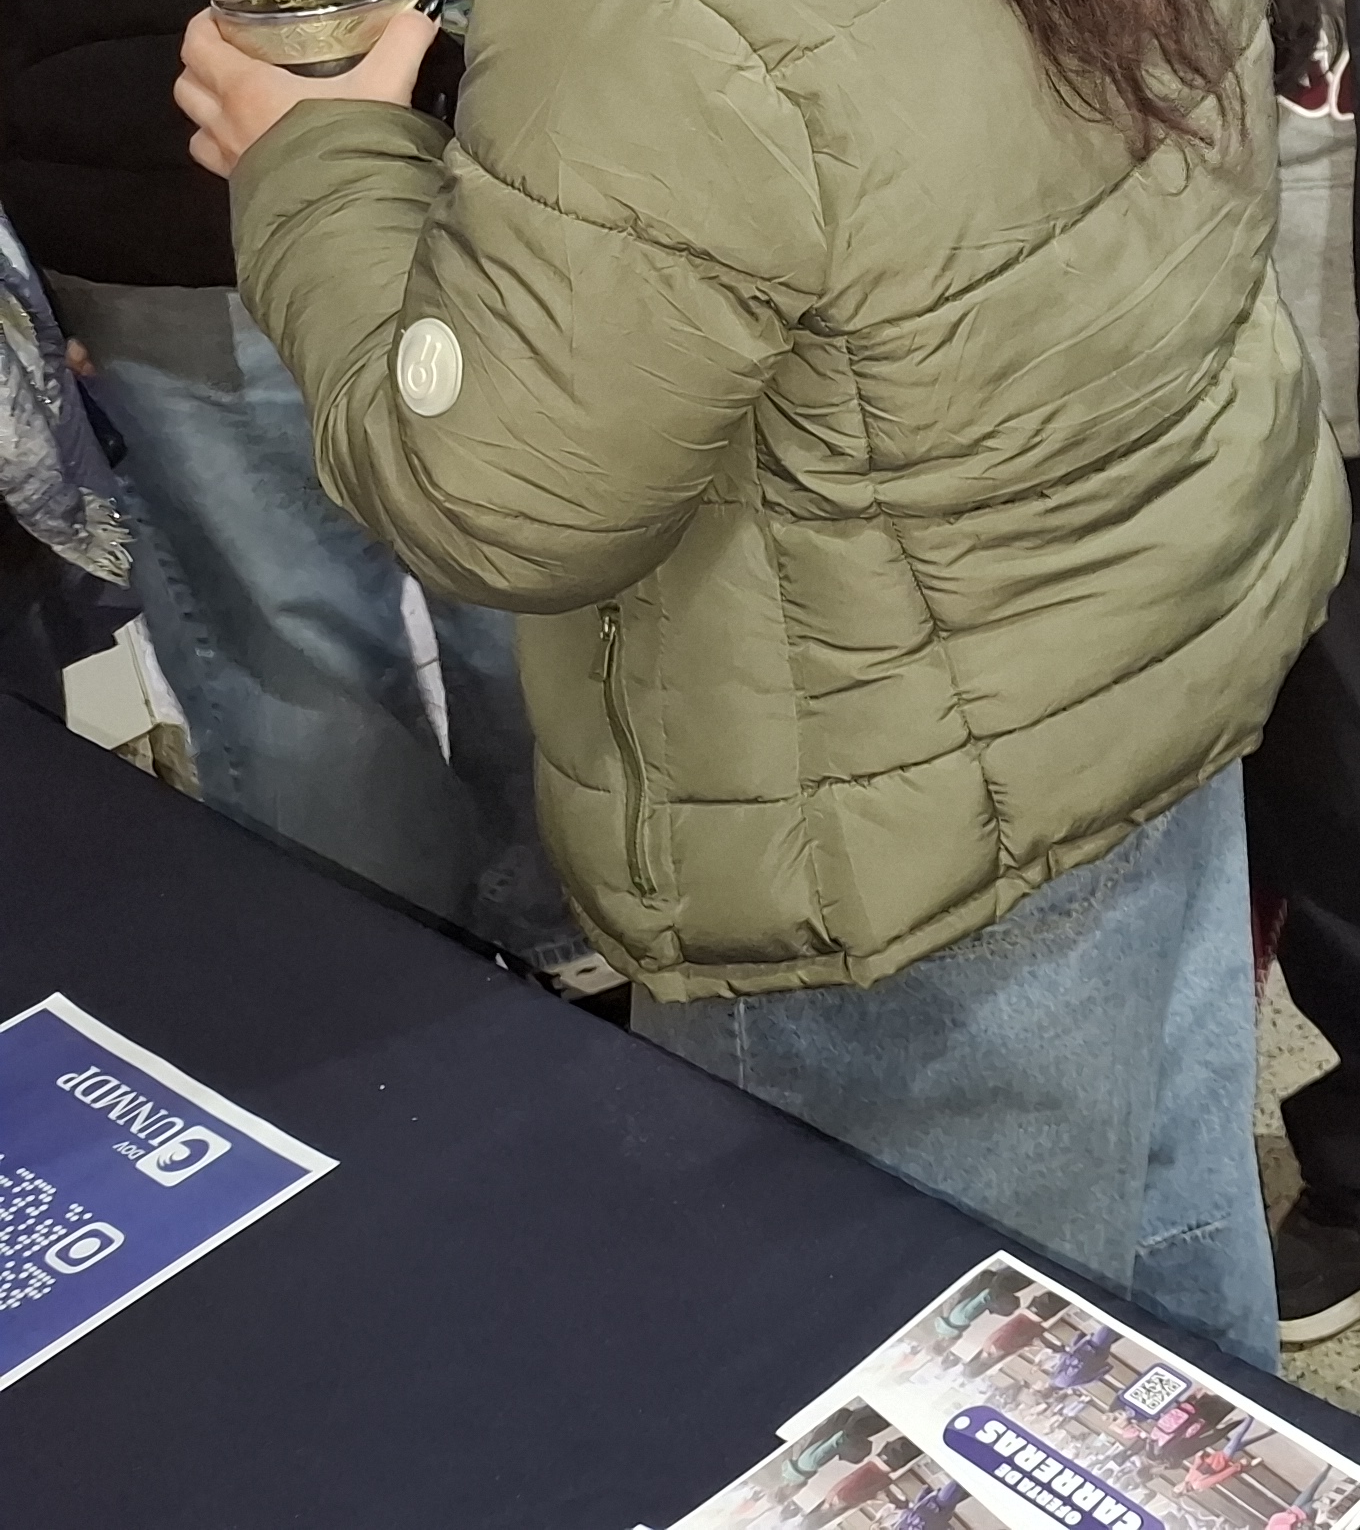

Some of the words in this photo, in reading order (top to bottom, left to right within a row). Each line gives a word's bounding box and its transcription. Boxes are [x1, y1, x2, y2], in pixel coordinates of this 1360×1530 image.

[55, 1065, 185, 1148] UNMDP
[974, 1419, 1145, 1530] CARRERAS
[993, 1462, 1023, 1486] DE
[1016, 1477, 1083, 1526] OFERTA
